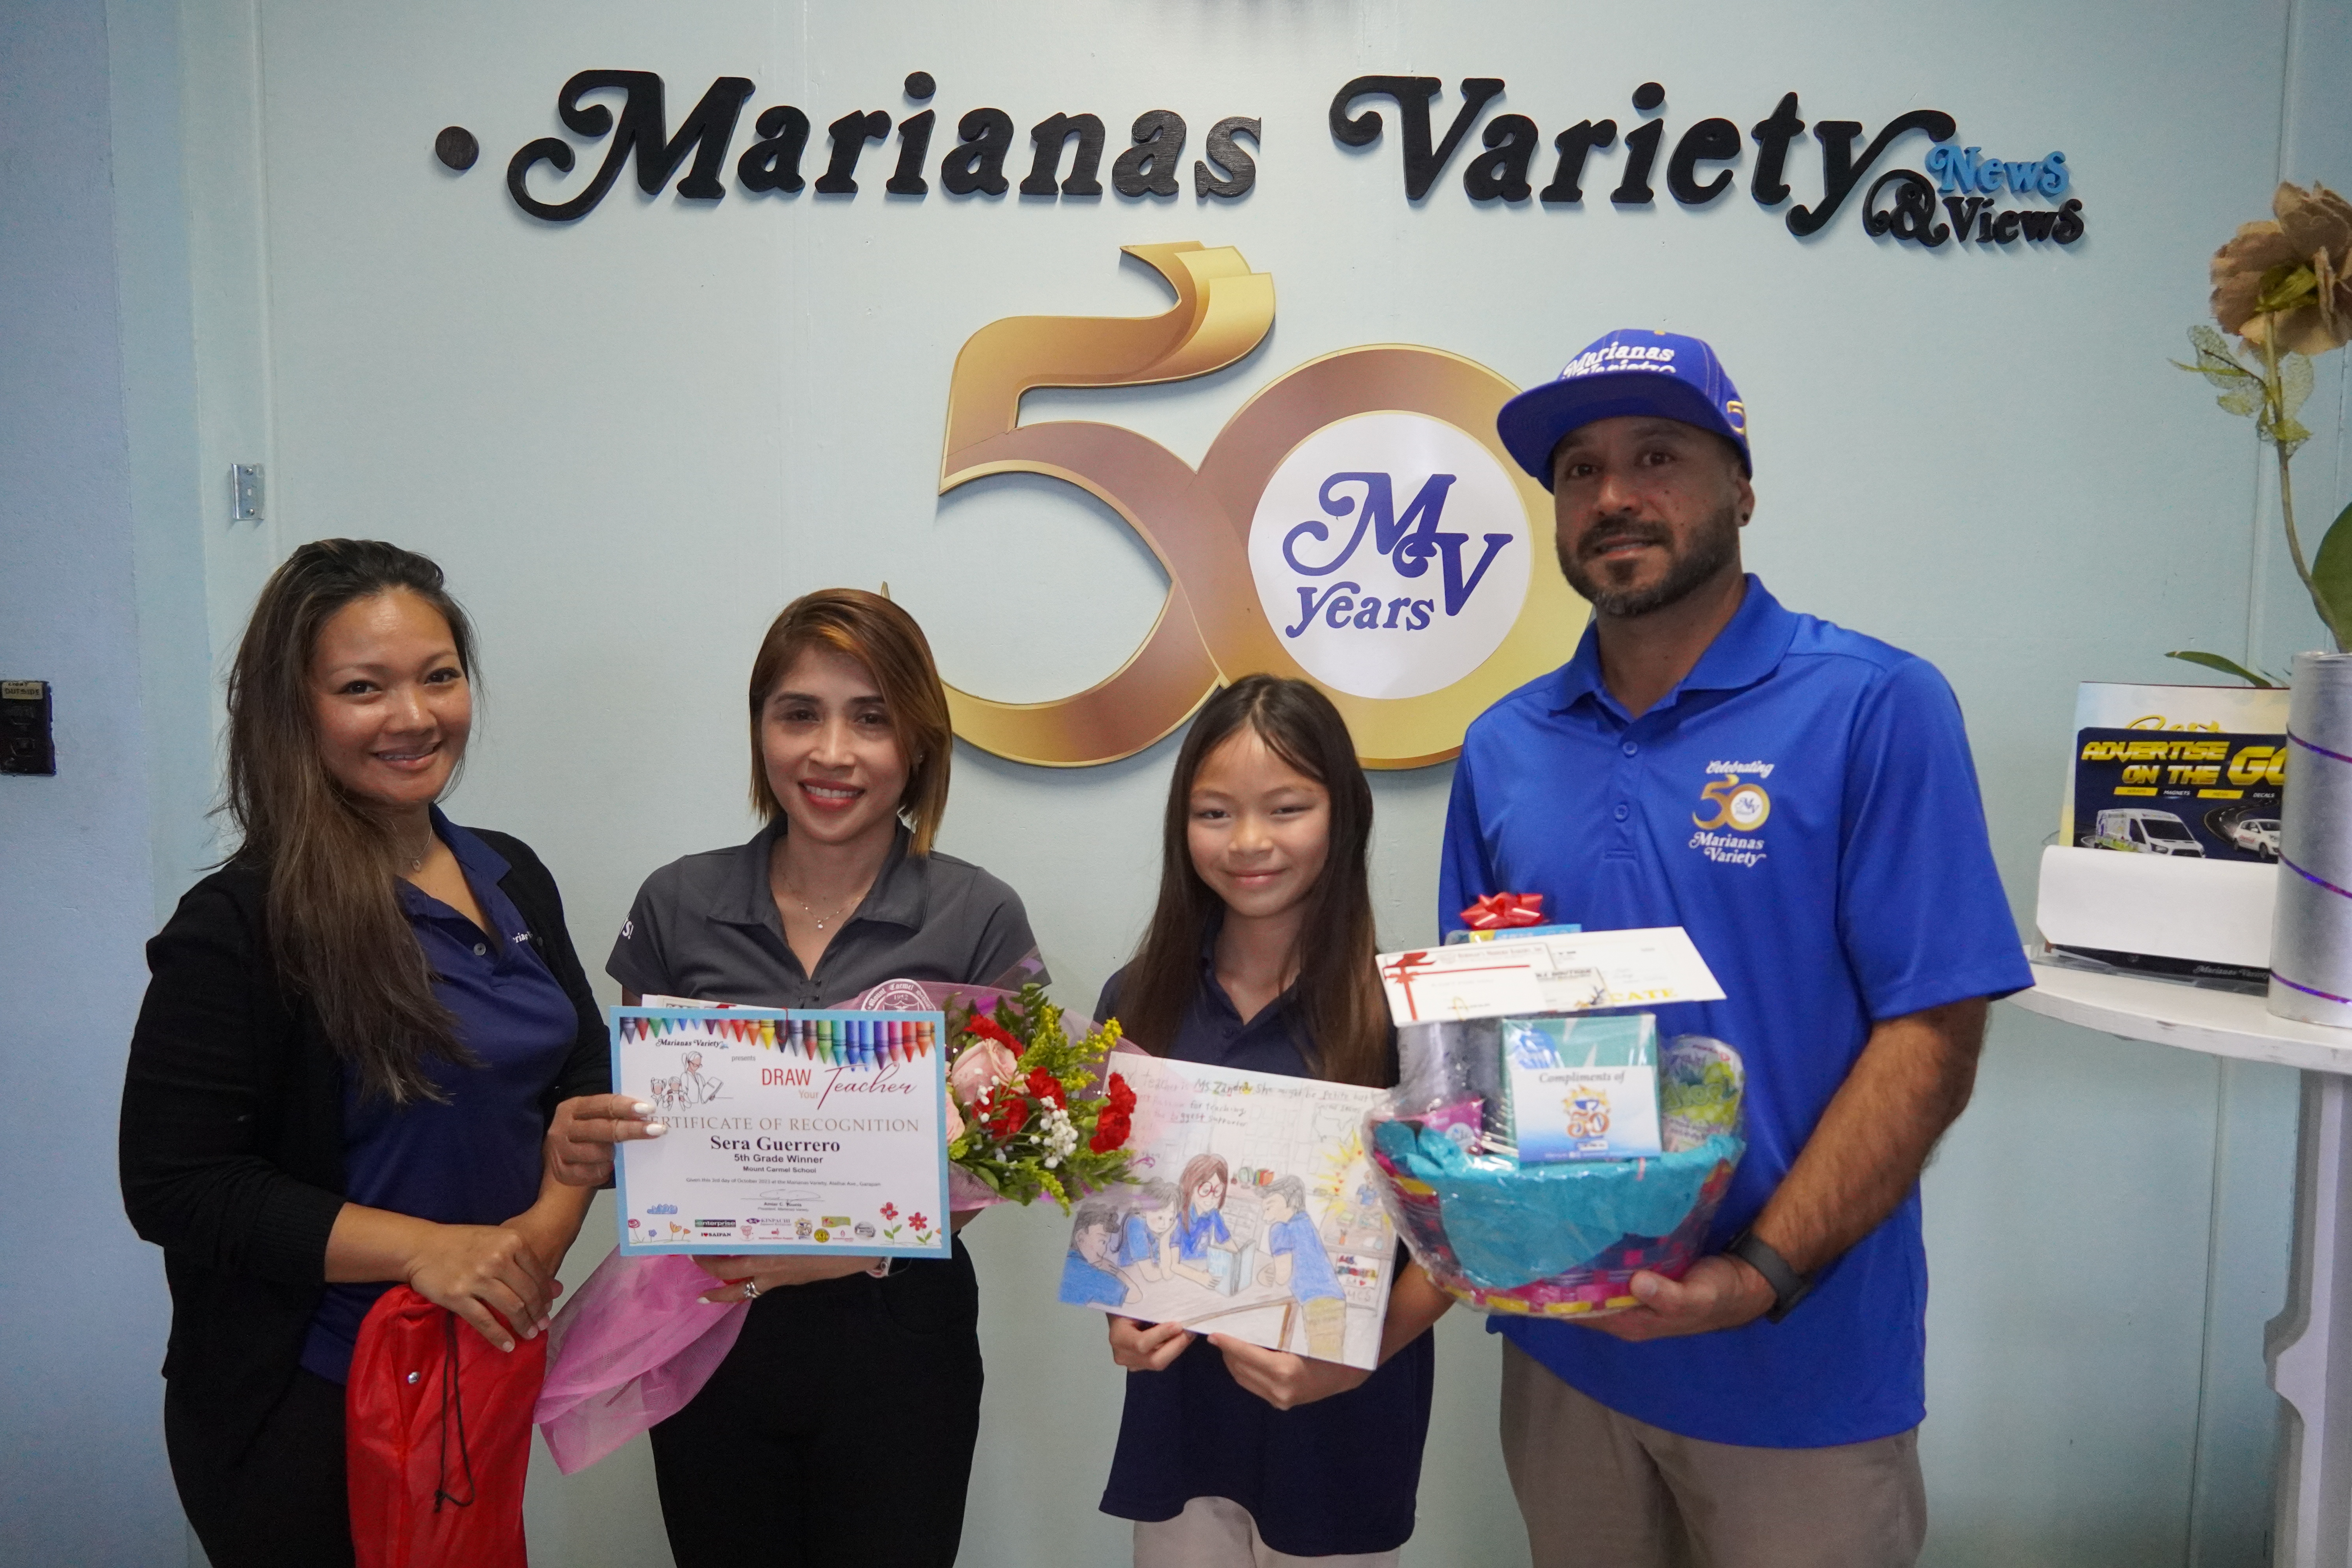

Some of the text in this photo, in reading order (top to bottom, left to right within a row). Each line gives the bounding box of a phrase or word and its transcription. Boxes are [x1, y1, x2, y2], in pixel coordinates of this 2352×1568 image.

[507, 69, 1957, 236] Marianas Variety
[1925, 143, 2072, 197] News
[1562, 341, 1675, 379] Marianas
[1285, 581, 1435, 639] years
[2081, 741, 2230, 762] ADVERTISE
[1706, 760, 1775, 779] Celebrating
[2122, 764, 2161, 784] ON
[2167, 765, 2221, 784] THE
[1692, 774, 1771, 831] 50
[1688, 831, 1765, 849] Marianas
[1703, 847, 1767, 867] Variety
[693, 1039, 722, 1048] Variety
[762, 1069, 811, 1086] DRAW
[817, 1062, 918, 1110] Teacher
[1539, 1070, 1626, 1085] Compliments of
[799, 1090, 819, 1099] Your
[645, 1116, 919, 1132] ERTIFICATE OF RECOGNITION
[710, 1135, 840, 1152] Sera Guerrero
[734, 1153, 824, 1163] 5th Grade Winner
